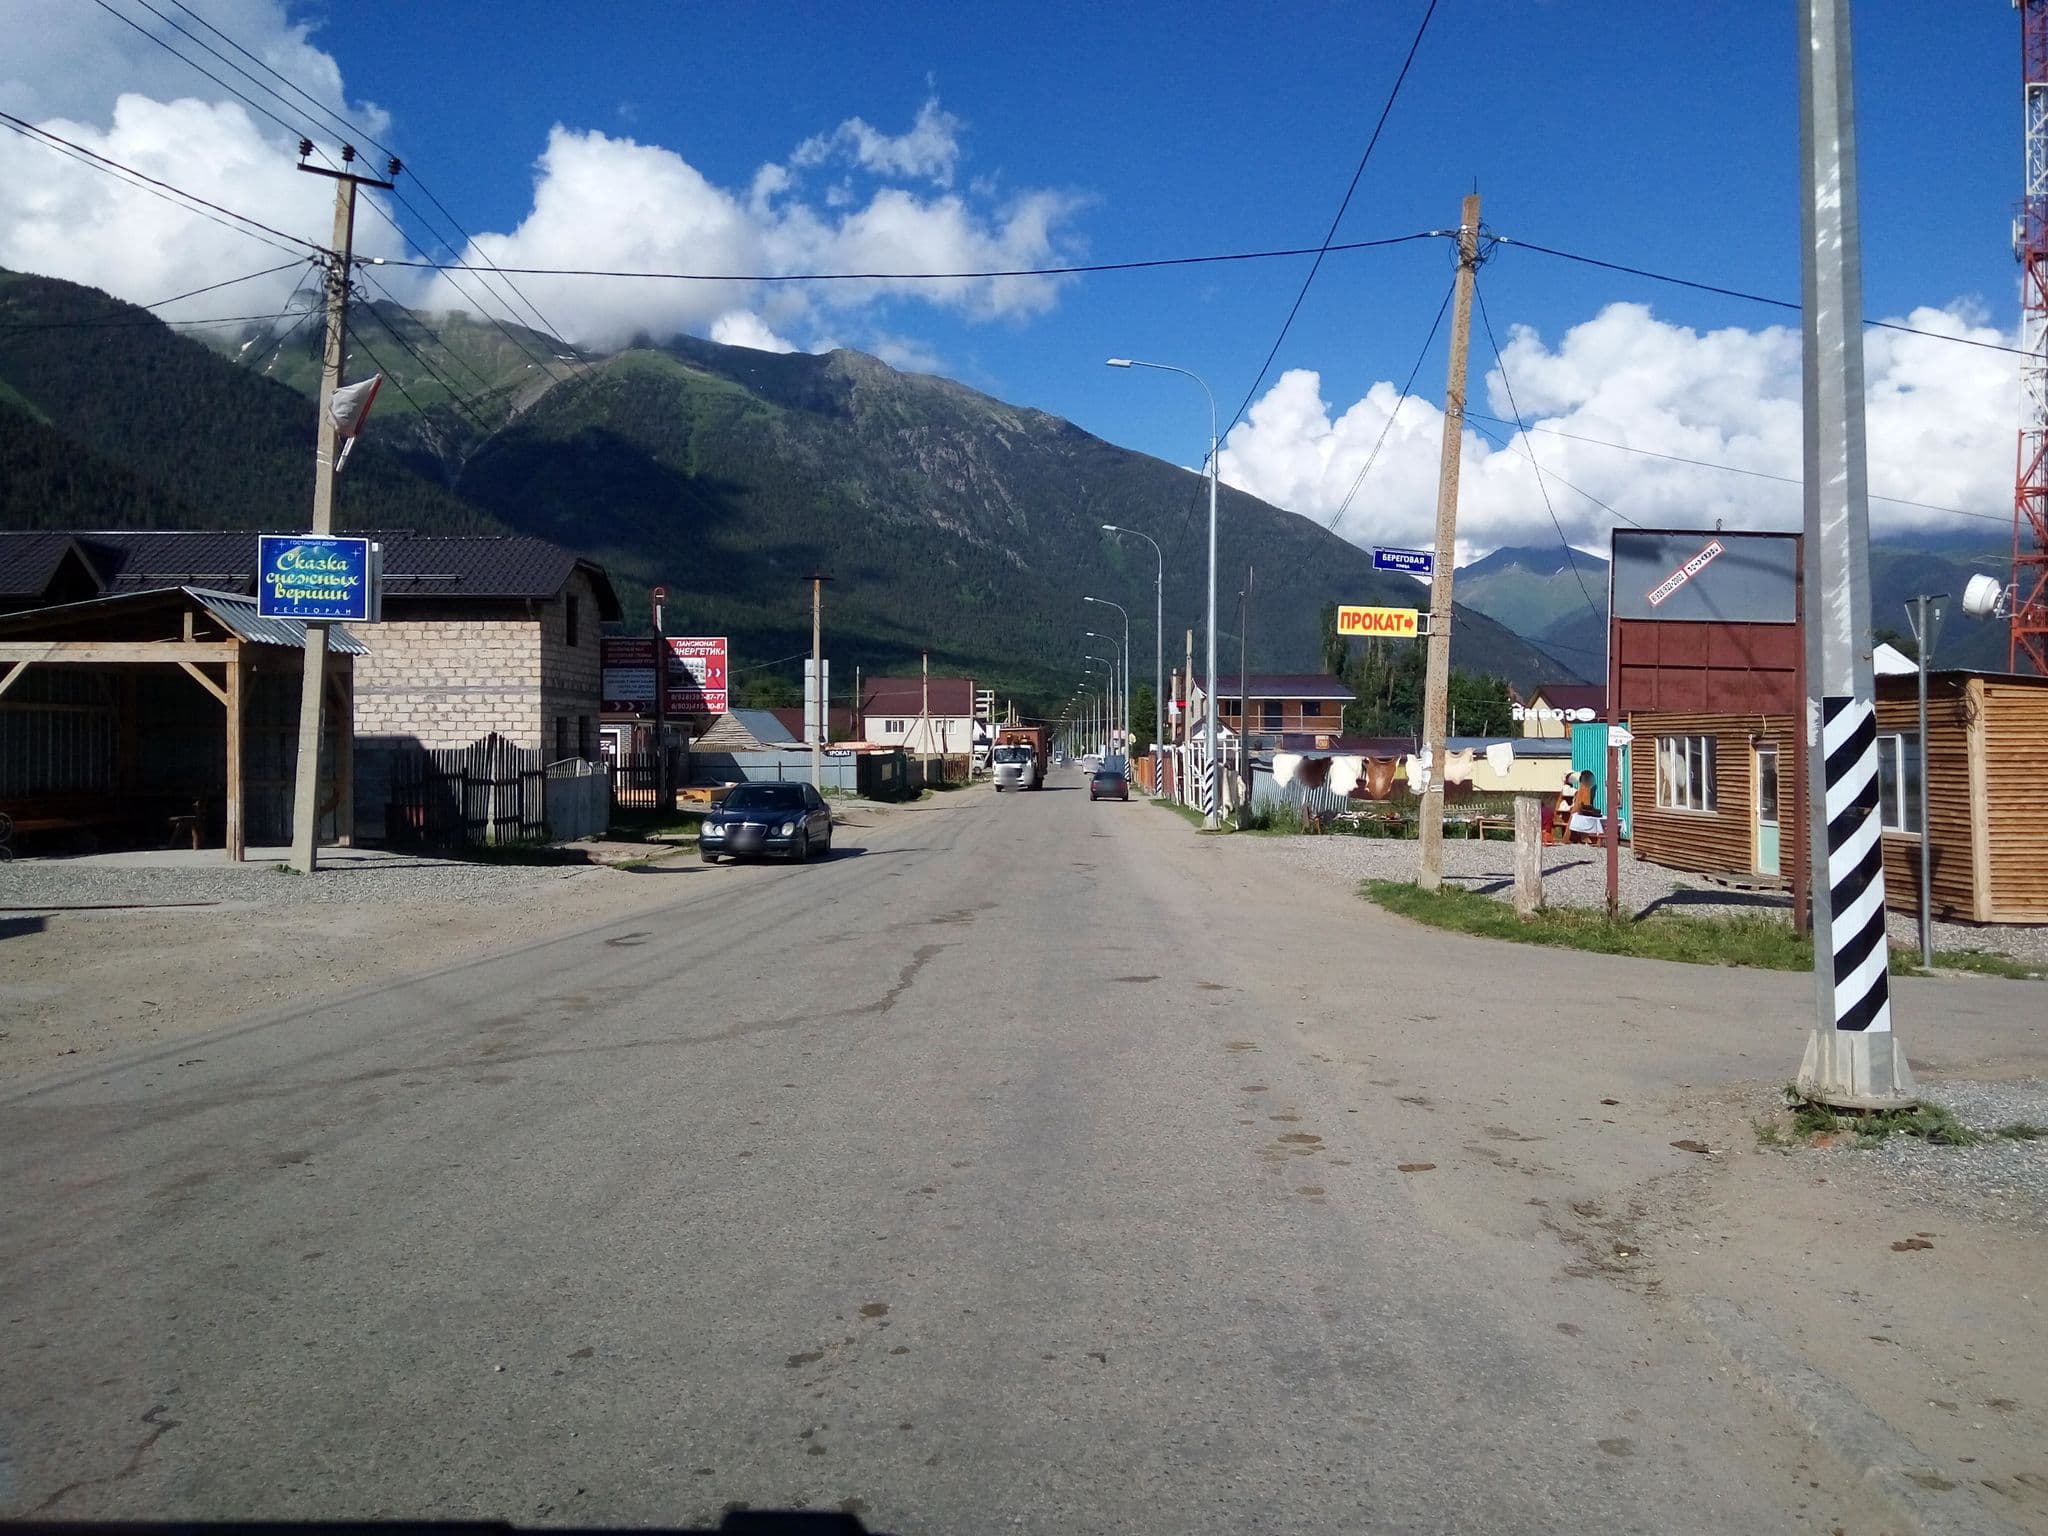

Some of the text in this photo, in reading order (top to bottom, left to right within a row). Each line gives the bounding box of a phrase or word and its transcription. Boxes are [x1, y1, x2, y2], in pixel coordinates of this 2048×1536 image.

[276, 551, 350, 571] Сказка
[1382, 553, 1425, 564] БЕРЕГОВАЯ
[265, 572, 360, 587] снежных
[275, 583, 351, 605] вершин
[273, 606, 352, 615] РЕСТОРАН
[1340, 612, 1404, 631] ПРОКАТ
